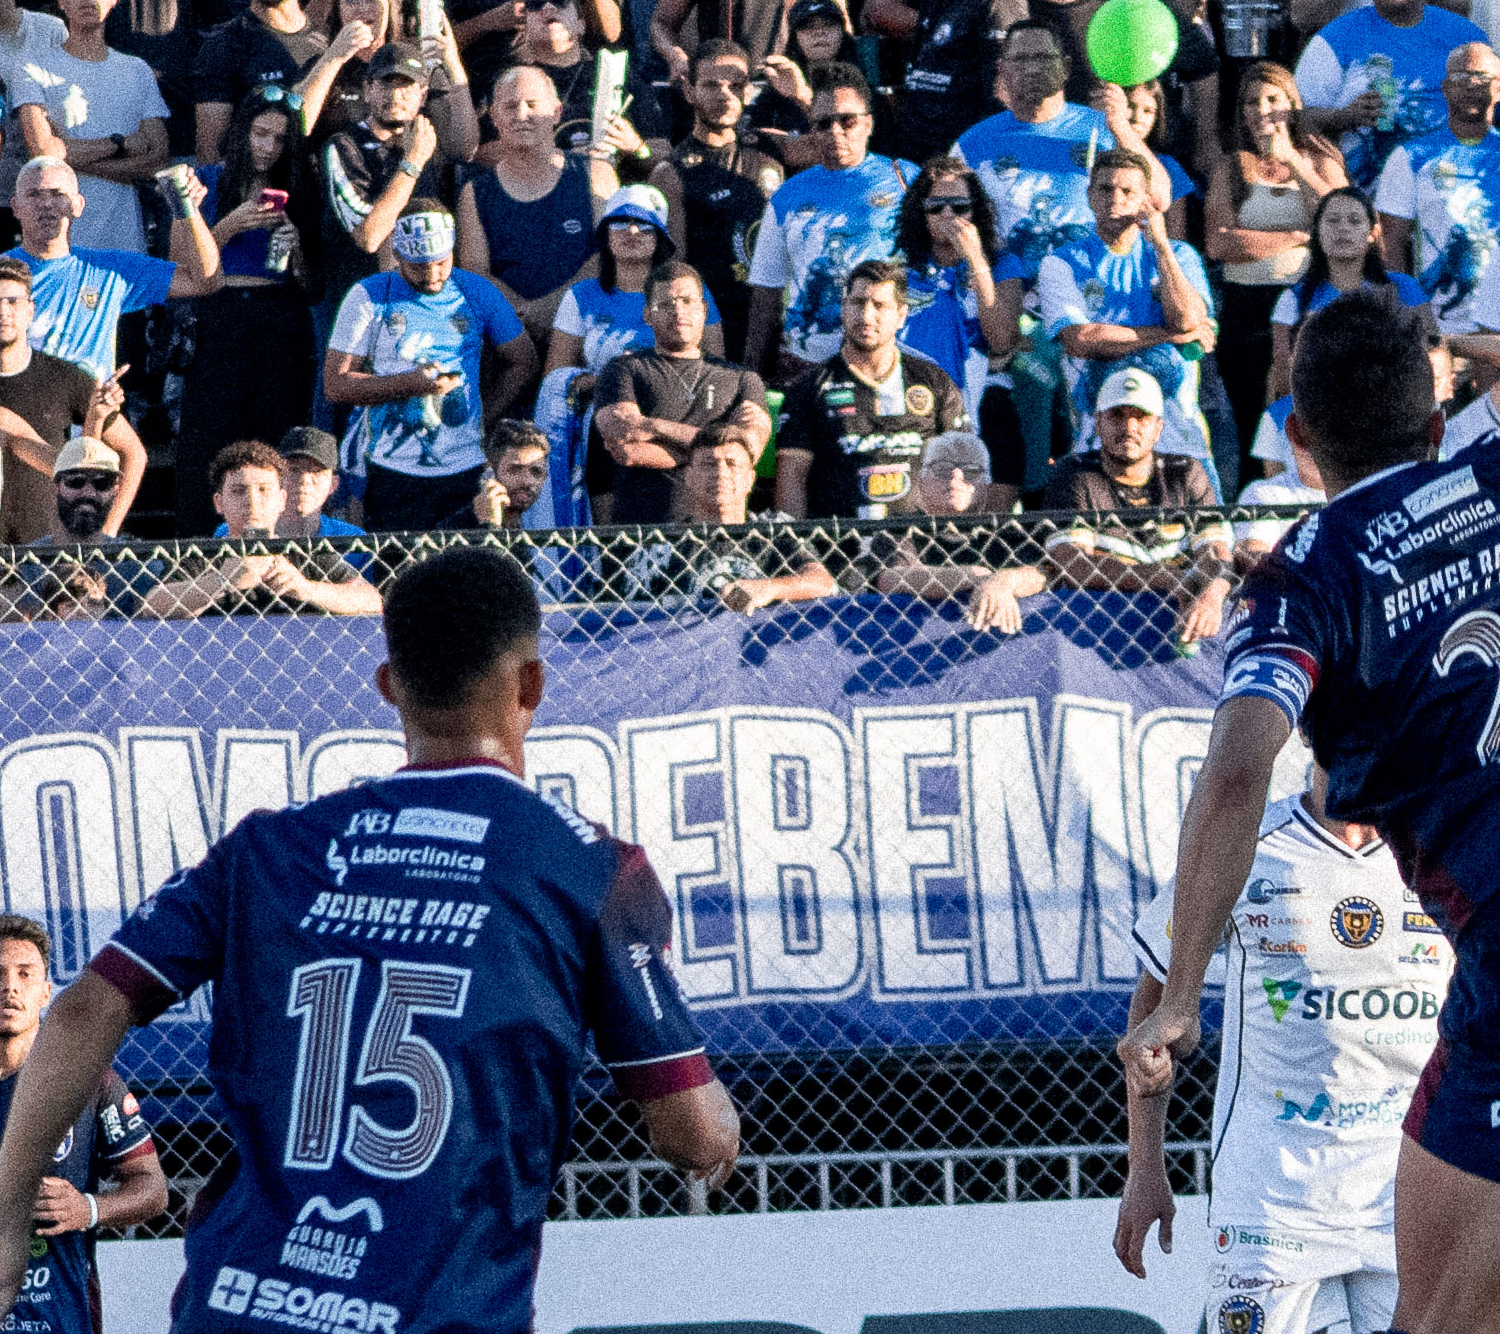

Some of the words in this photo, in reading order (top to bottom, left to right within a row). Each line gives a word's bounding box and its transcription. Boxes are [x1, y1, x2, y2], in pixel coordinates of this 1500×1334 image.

[1384, 555, 1474, 622] SCIENCE
[309, 890, 416, 929] SCIENCE
[418, 895, 492, 932] RAGE
[1301, 987, 1439, 1021] SICOOB
[284, 956, 473, 1180] 15
[280, 1243, 363, 1280] MANSÕES
[256, 1276, 400, 1334] SOMAR
